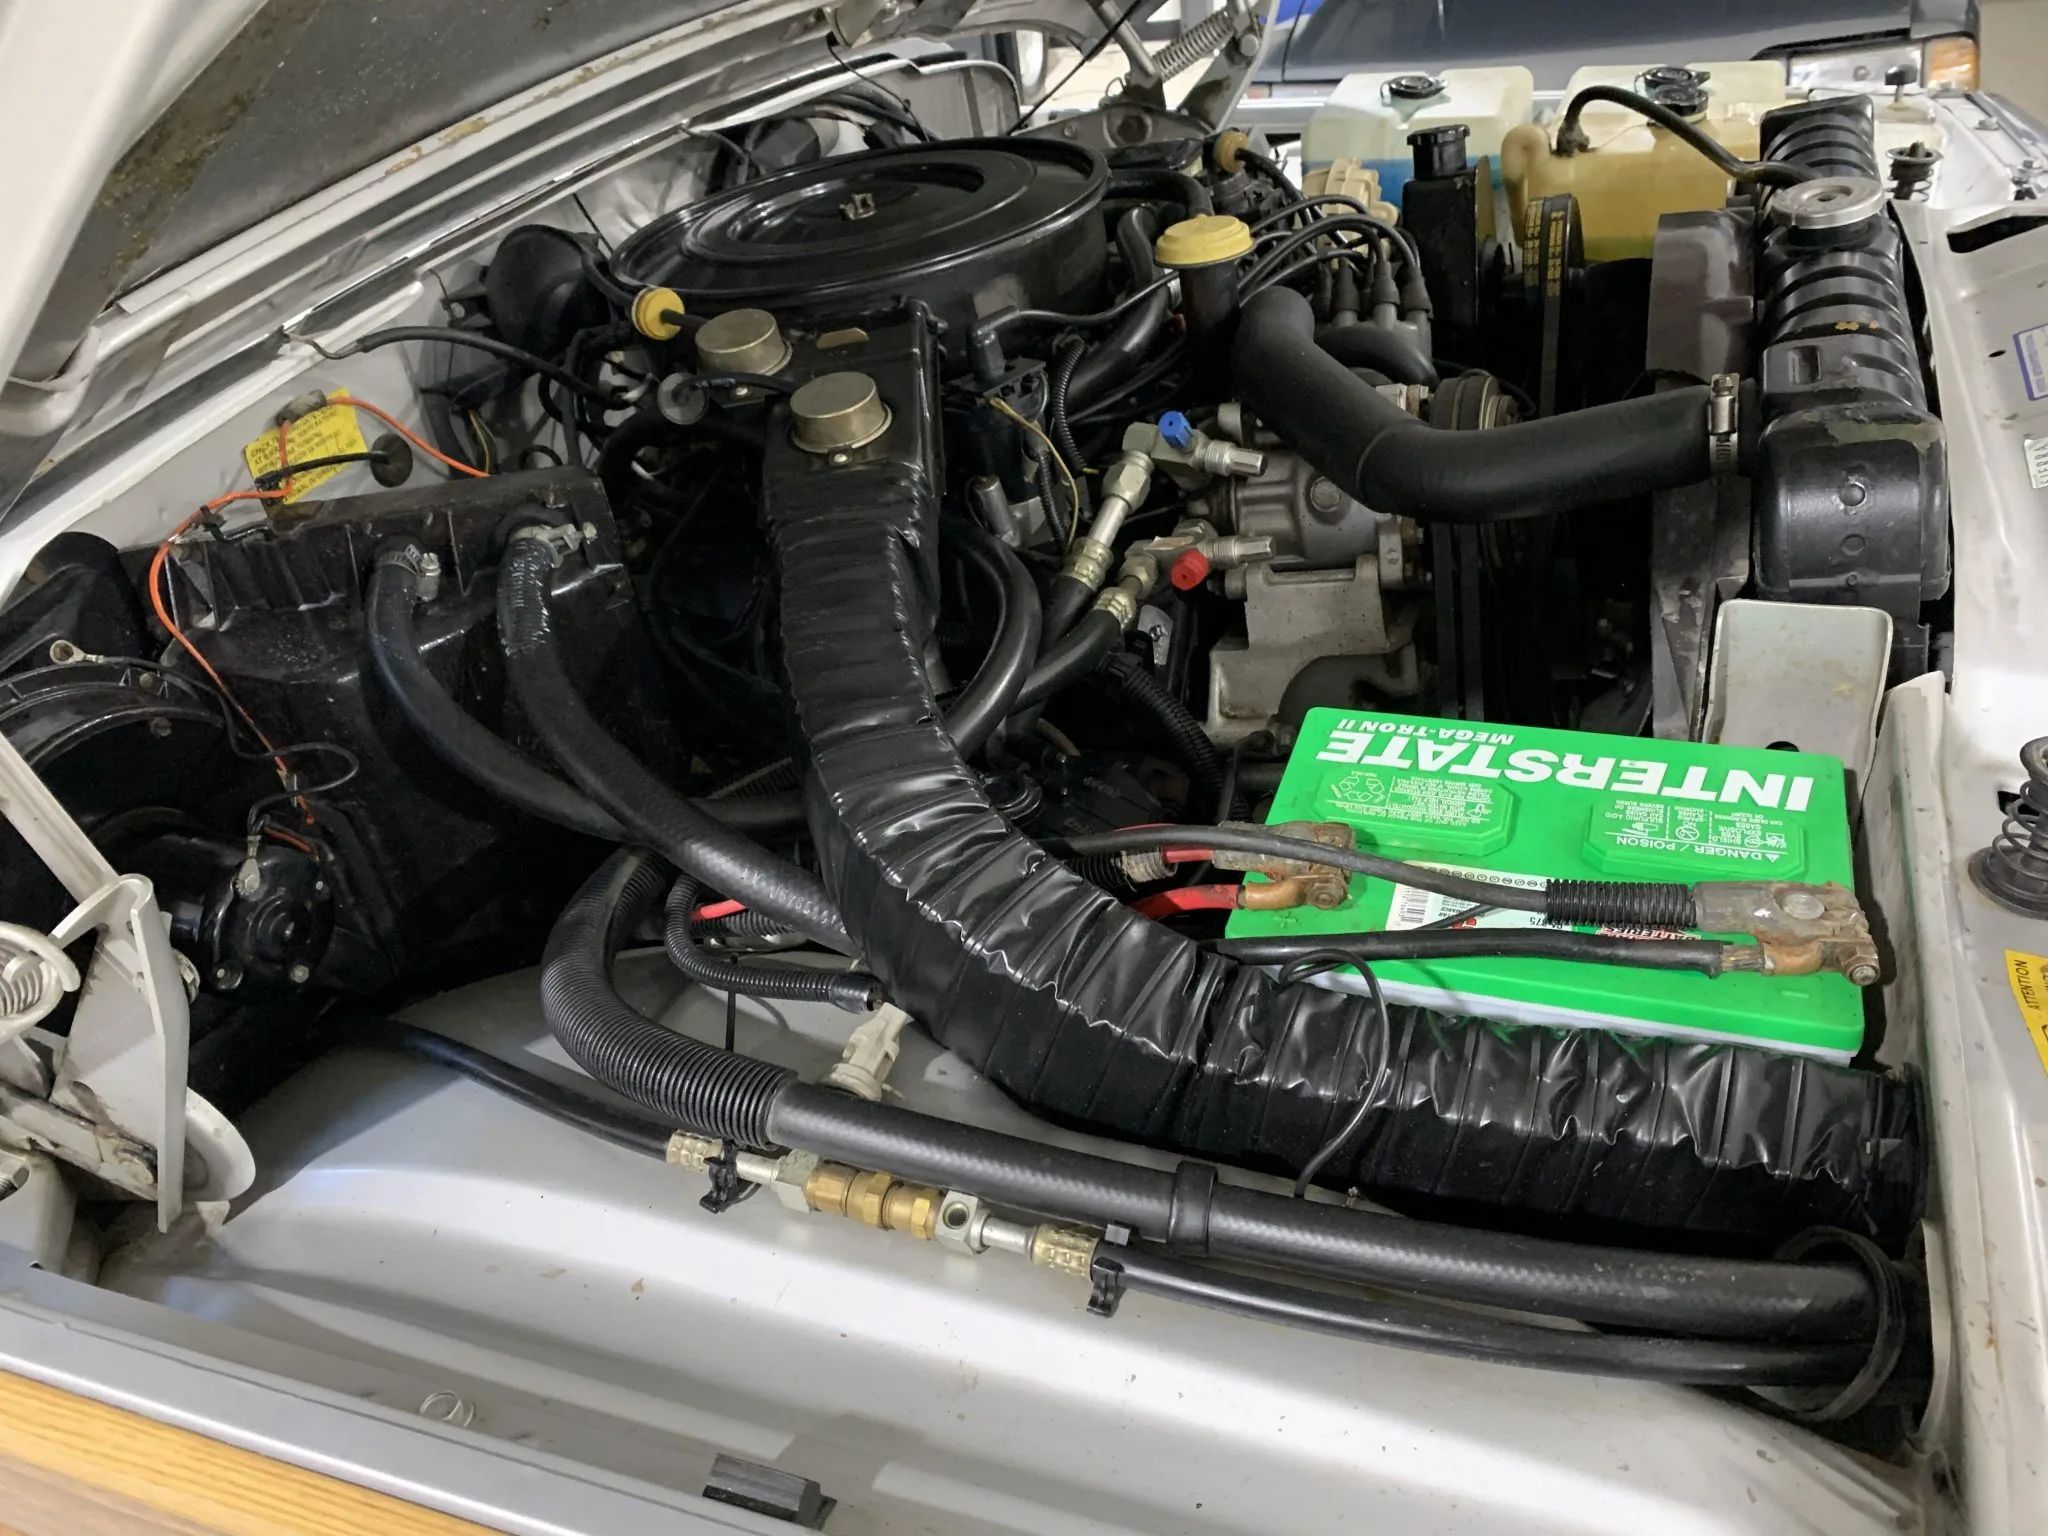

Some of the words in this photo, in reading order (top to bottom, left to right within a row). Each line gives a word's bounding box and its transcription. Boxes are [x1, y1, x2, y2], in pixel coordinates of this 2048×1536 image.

[1356, 720, 1515, 745] MEGA-TRON
[1315, 729, 1815, 811] INTERSTATE
[1605, 811, 1624, 820] ACID
[1625, 814, 1664, 825] SULFURIC
[1682, 821, 1697, 829] NO
[1616, 836, 1676, 850] POISON
[1712, 835, 1742, 845] SHIELD
[1695, 845, 1762, 861] DANGER
[2014, 959, 2042, 1011] ATTENTION
